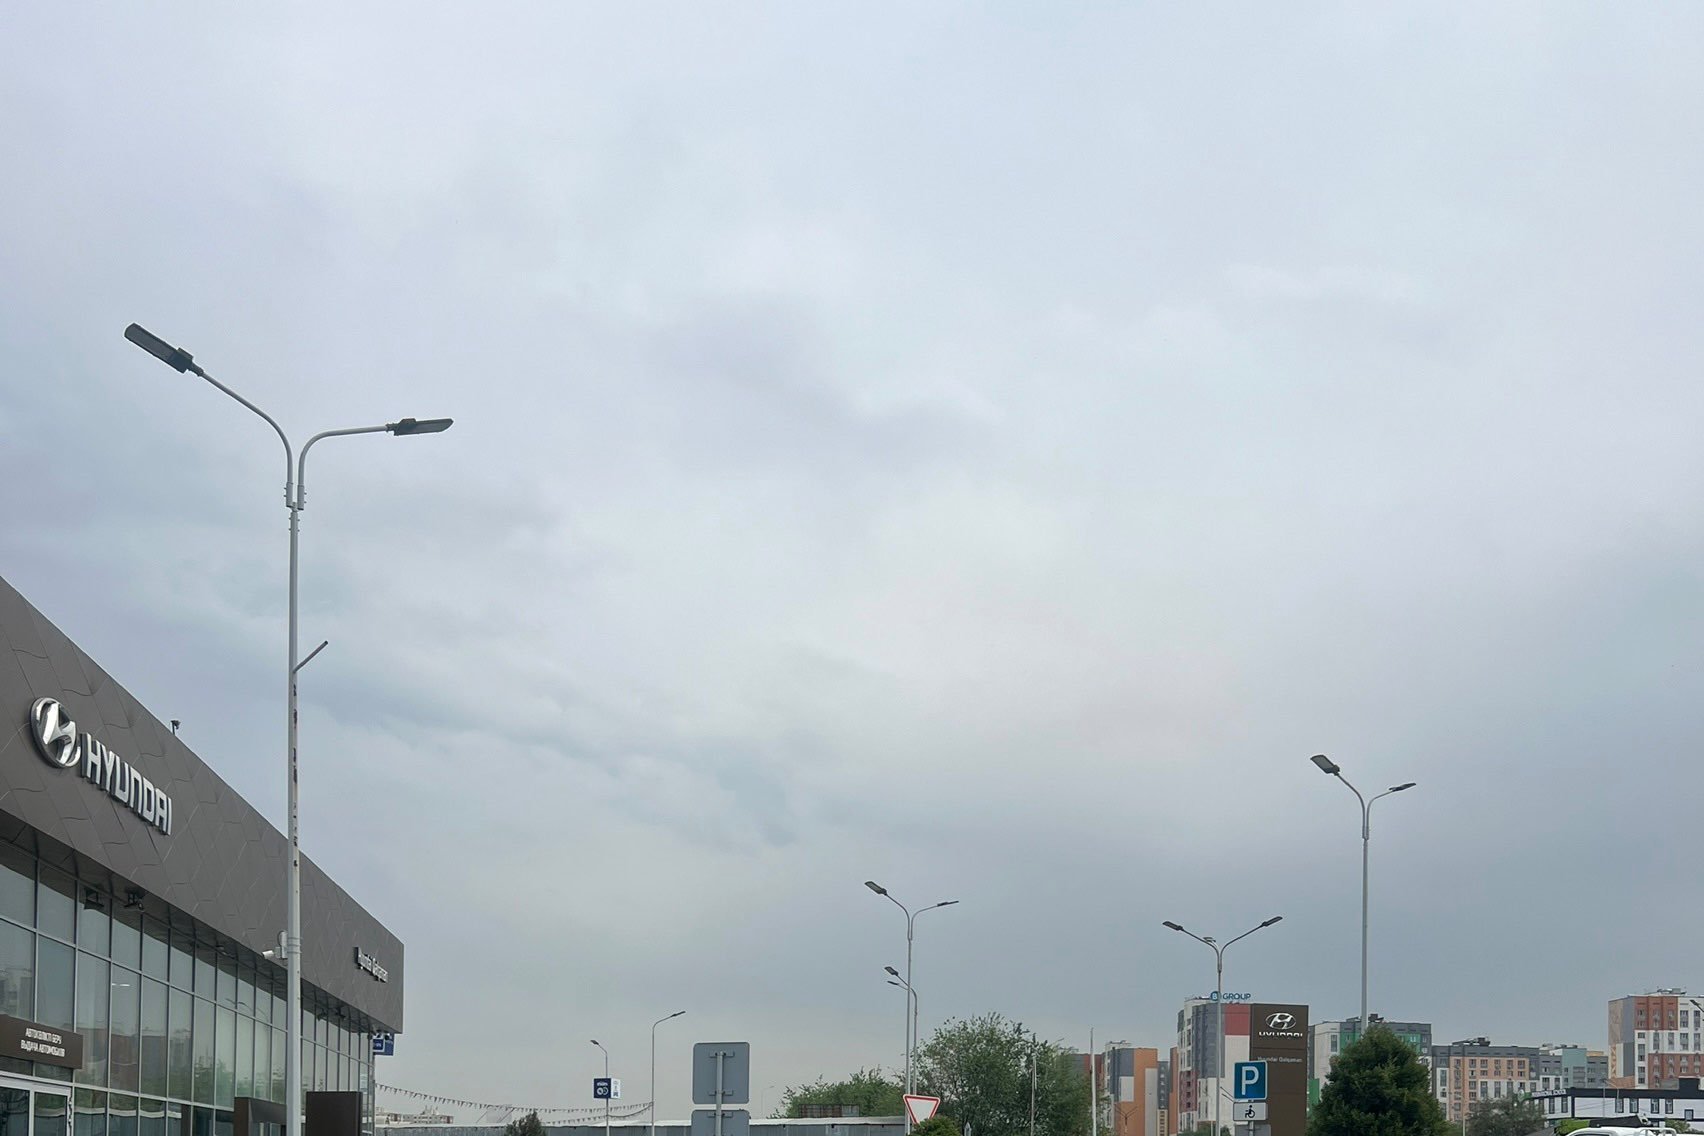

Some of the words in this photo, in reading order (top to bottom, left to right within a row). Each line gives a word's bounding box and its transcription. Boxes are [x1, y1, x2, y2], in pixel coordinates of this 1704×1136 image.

[80, 731, 172, 836] HYUNDAI
[1223, 992, 1251, 1000] GROUP
[1241, 1065, 1260, 1096] P
